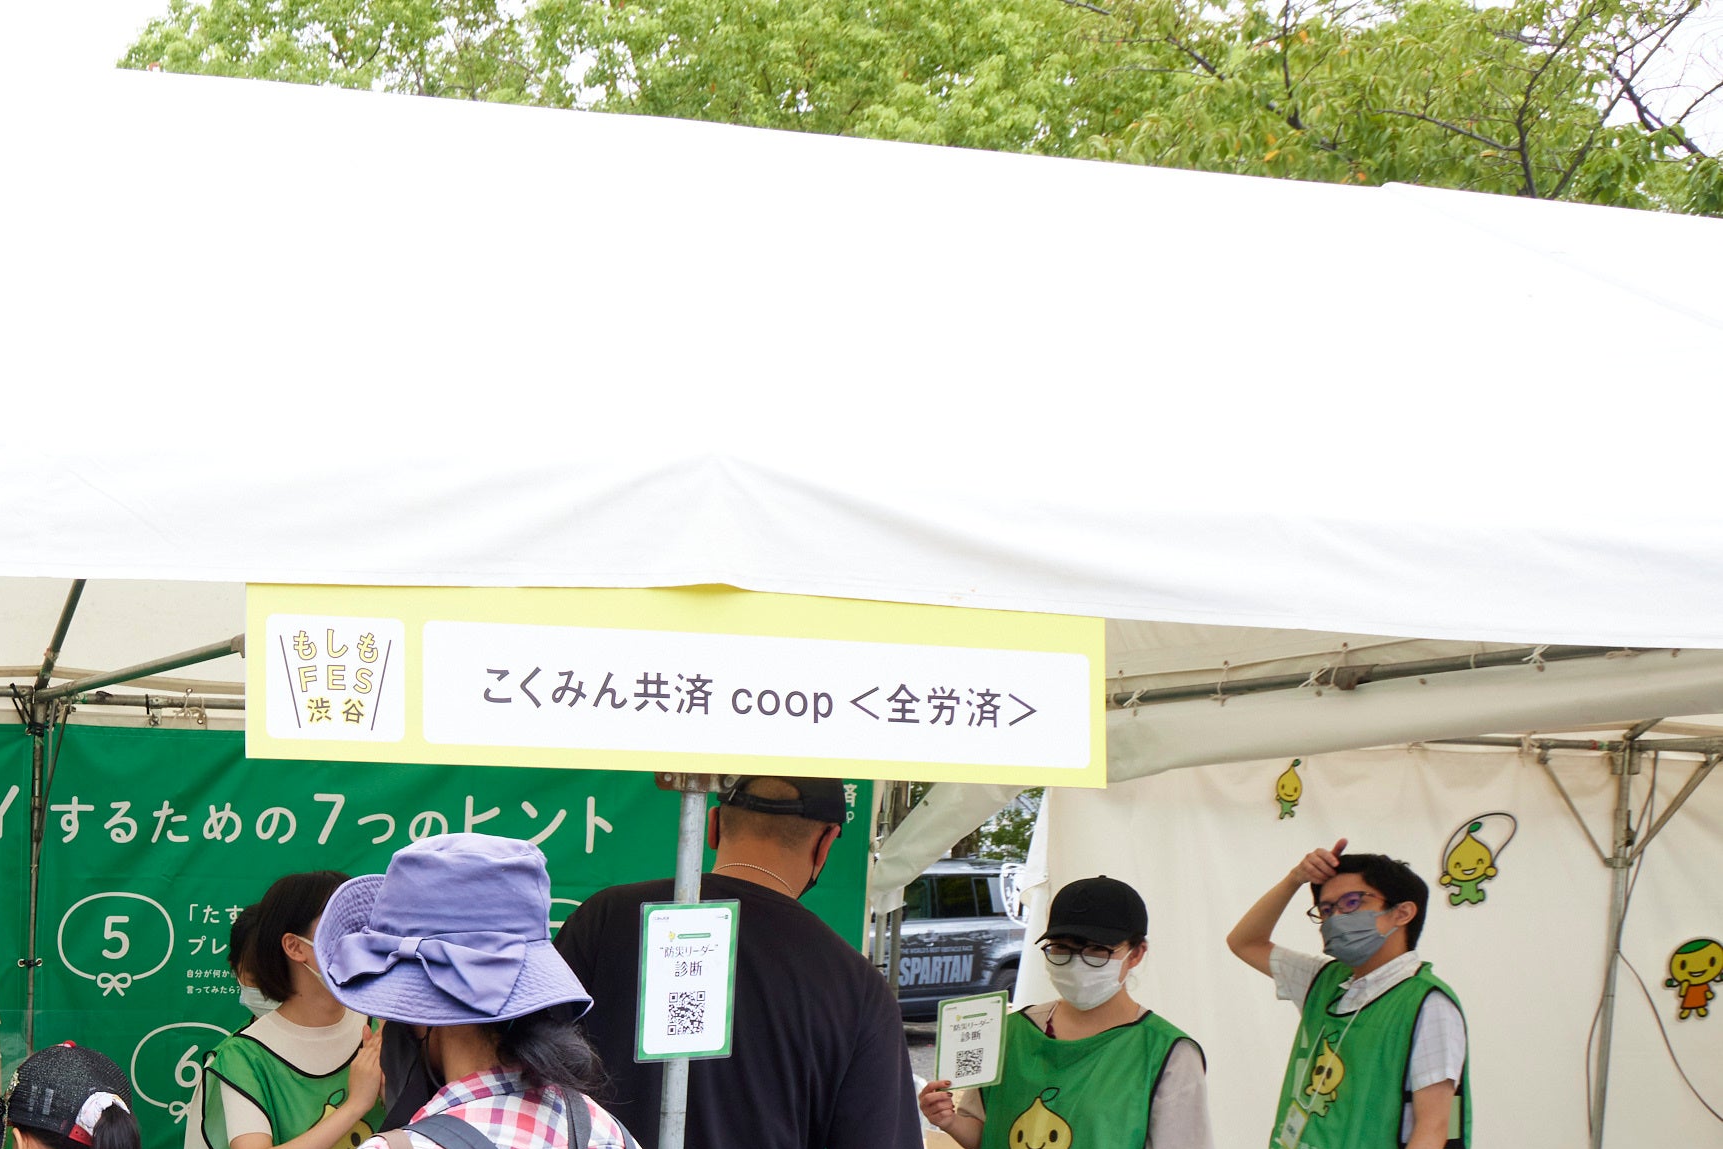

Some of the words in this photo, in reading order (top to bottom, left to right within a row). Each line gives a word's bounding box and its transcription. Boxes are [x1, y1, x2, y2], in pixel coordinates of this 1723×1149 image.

[293, 628, 379, 664] もしも
[297, 664, 373, 695] FES
[483, 666, 714, 715] こくみん共済
[731, 686, 834, 724] coop
[307, 696, 365, 724] 渋谷
[101, 915, 130, 959] 5
[674, 960, 702, 977] 診断
[898, 955, 975, 987] SPARTAN
[174, 1044, 203, 1087] 6
